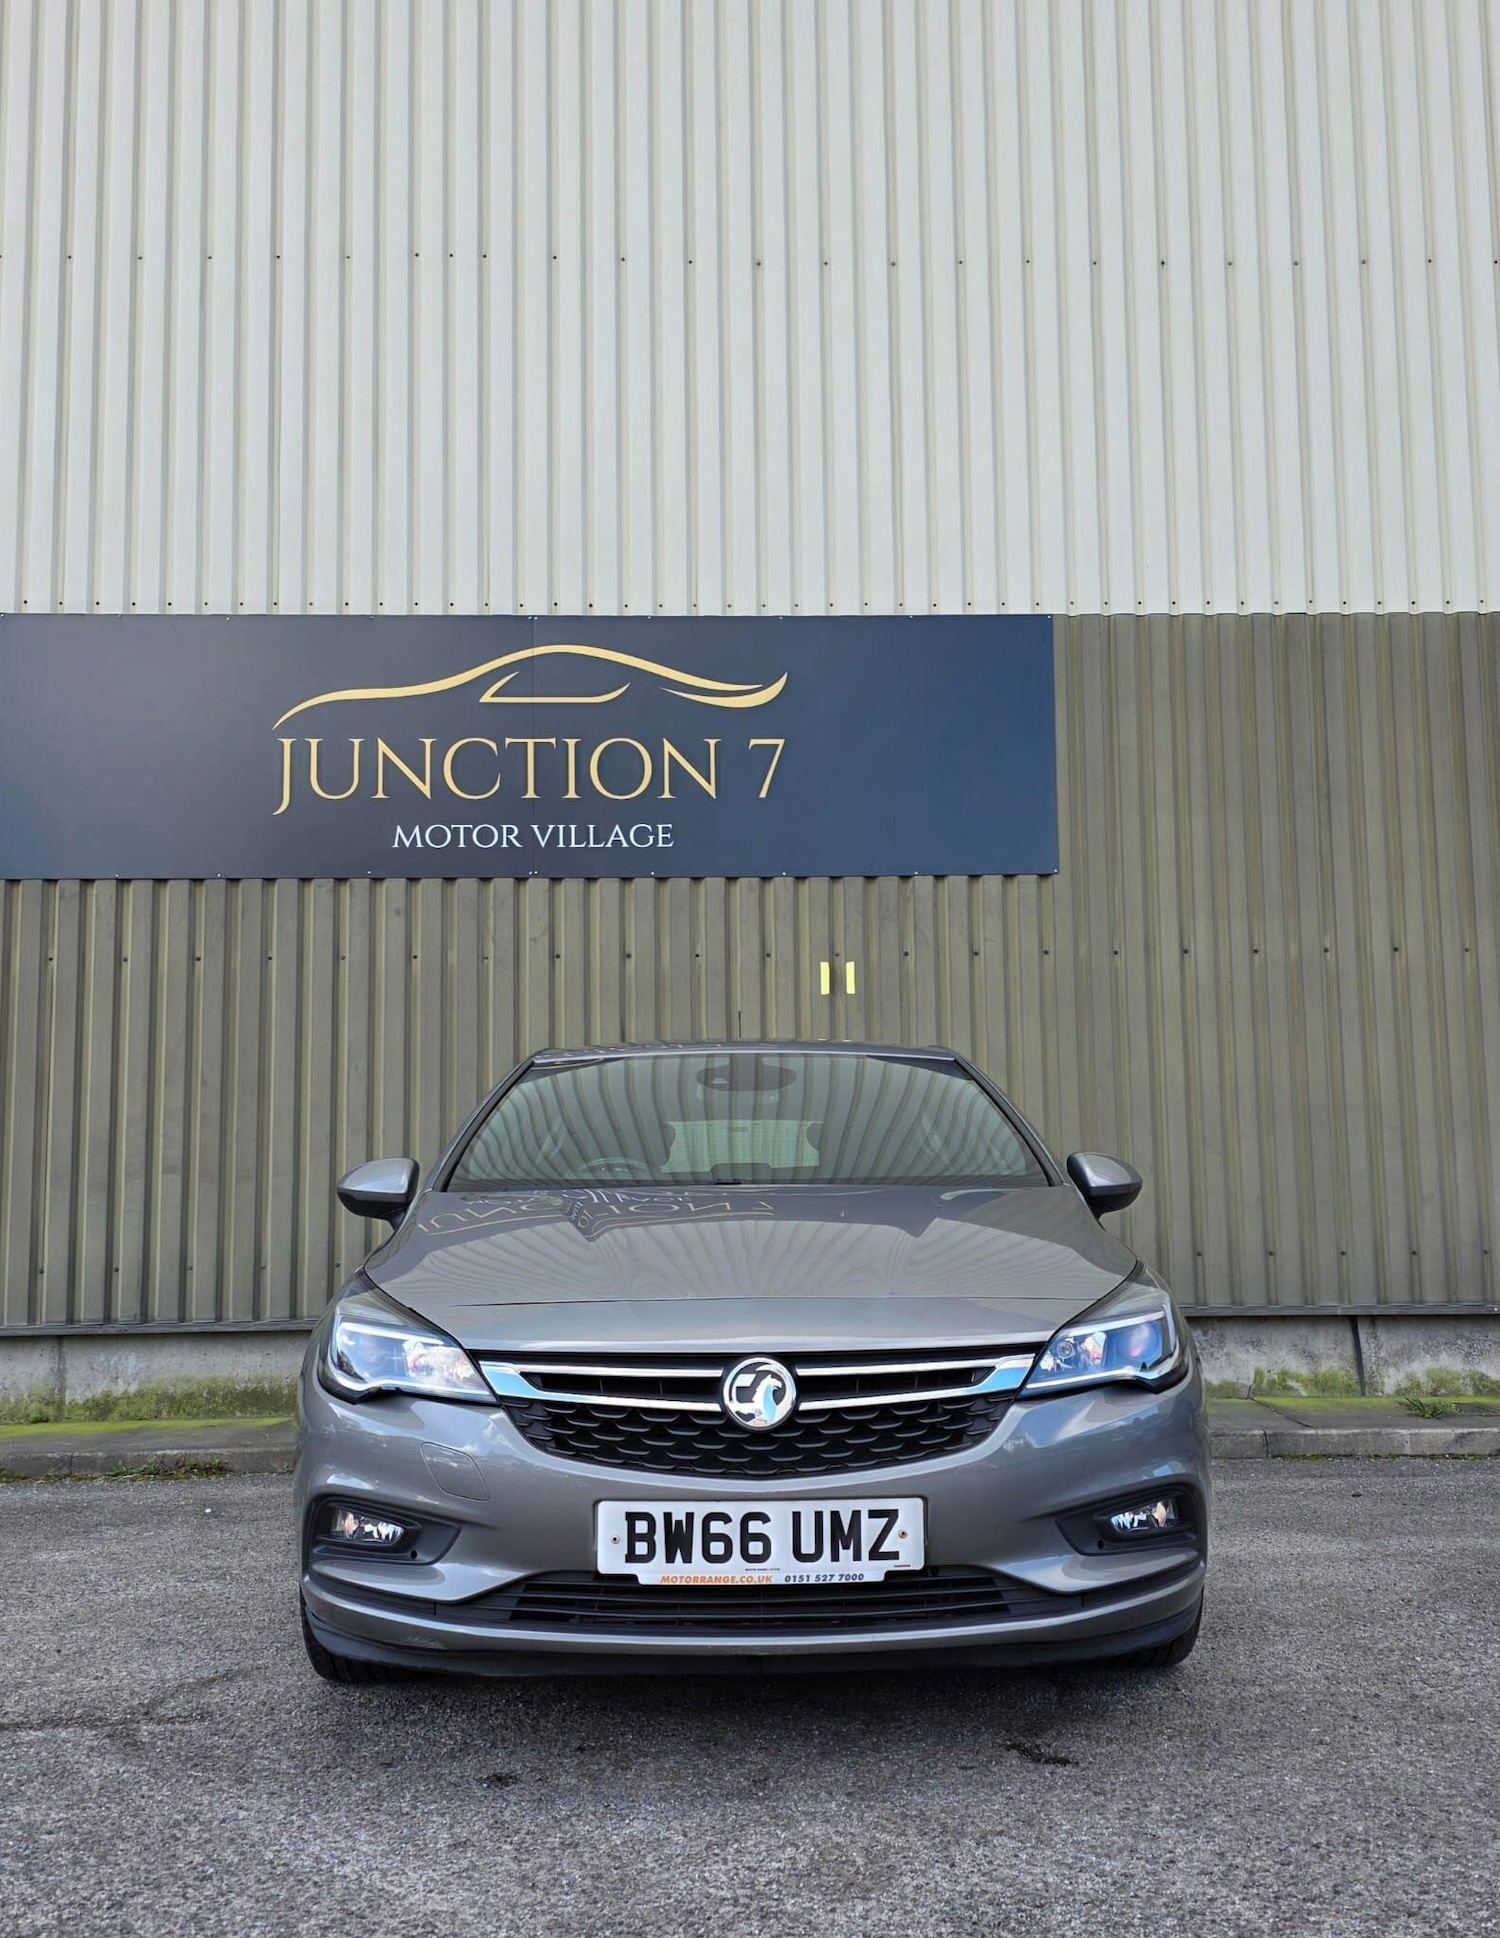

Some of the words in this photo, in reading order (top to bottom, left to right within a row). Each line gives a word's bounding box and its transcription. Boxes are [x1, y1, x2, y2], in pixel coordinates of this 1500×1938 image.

[272, 738, 721, 815] JUNCTION
[749, 738, 786, 799] 7
[391, 822, 523, 849] MOTOR
[531, 822, 674, 849] VILLAGE
[624, 1510, 772, 1564] BW66
[792, 1509, 900, 1562] UMZ
[660, 1575, 773, 1583] MOTORRANGE.CO.UK
[784, 1574, 811, 1583] 0151
[814, 1574, 835, 1582] 527
[838, 1573, 864, 1581] 7000
